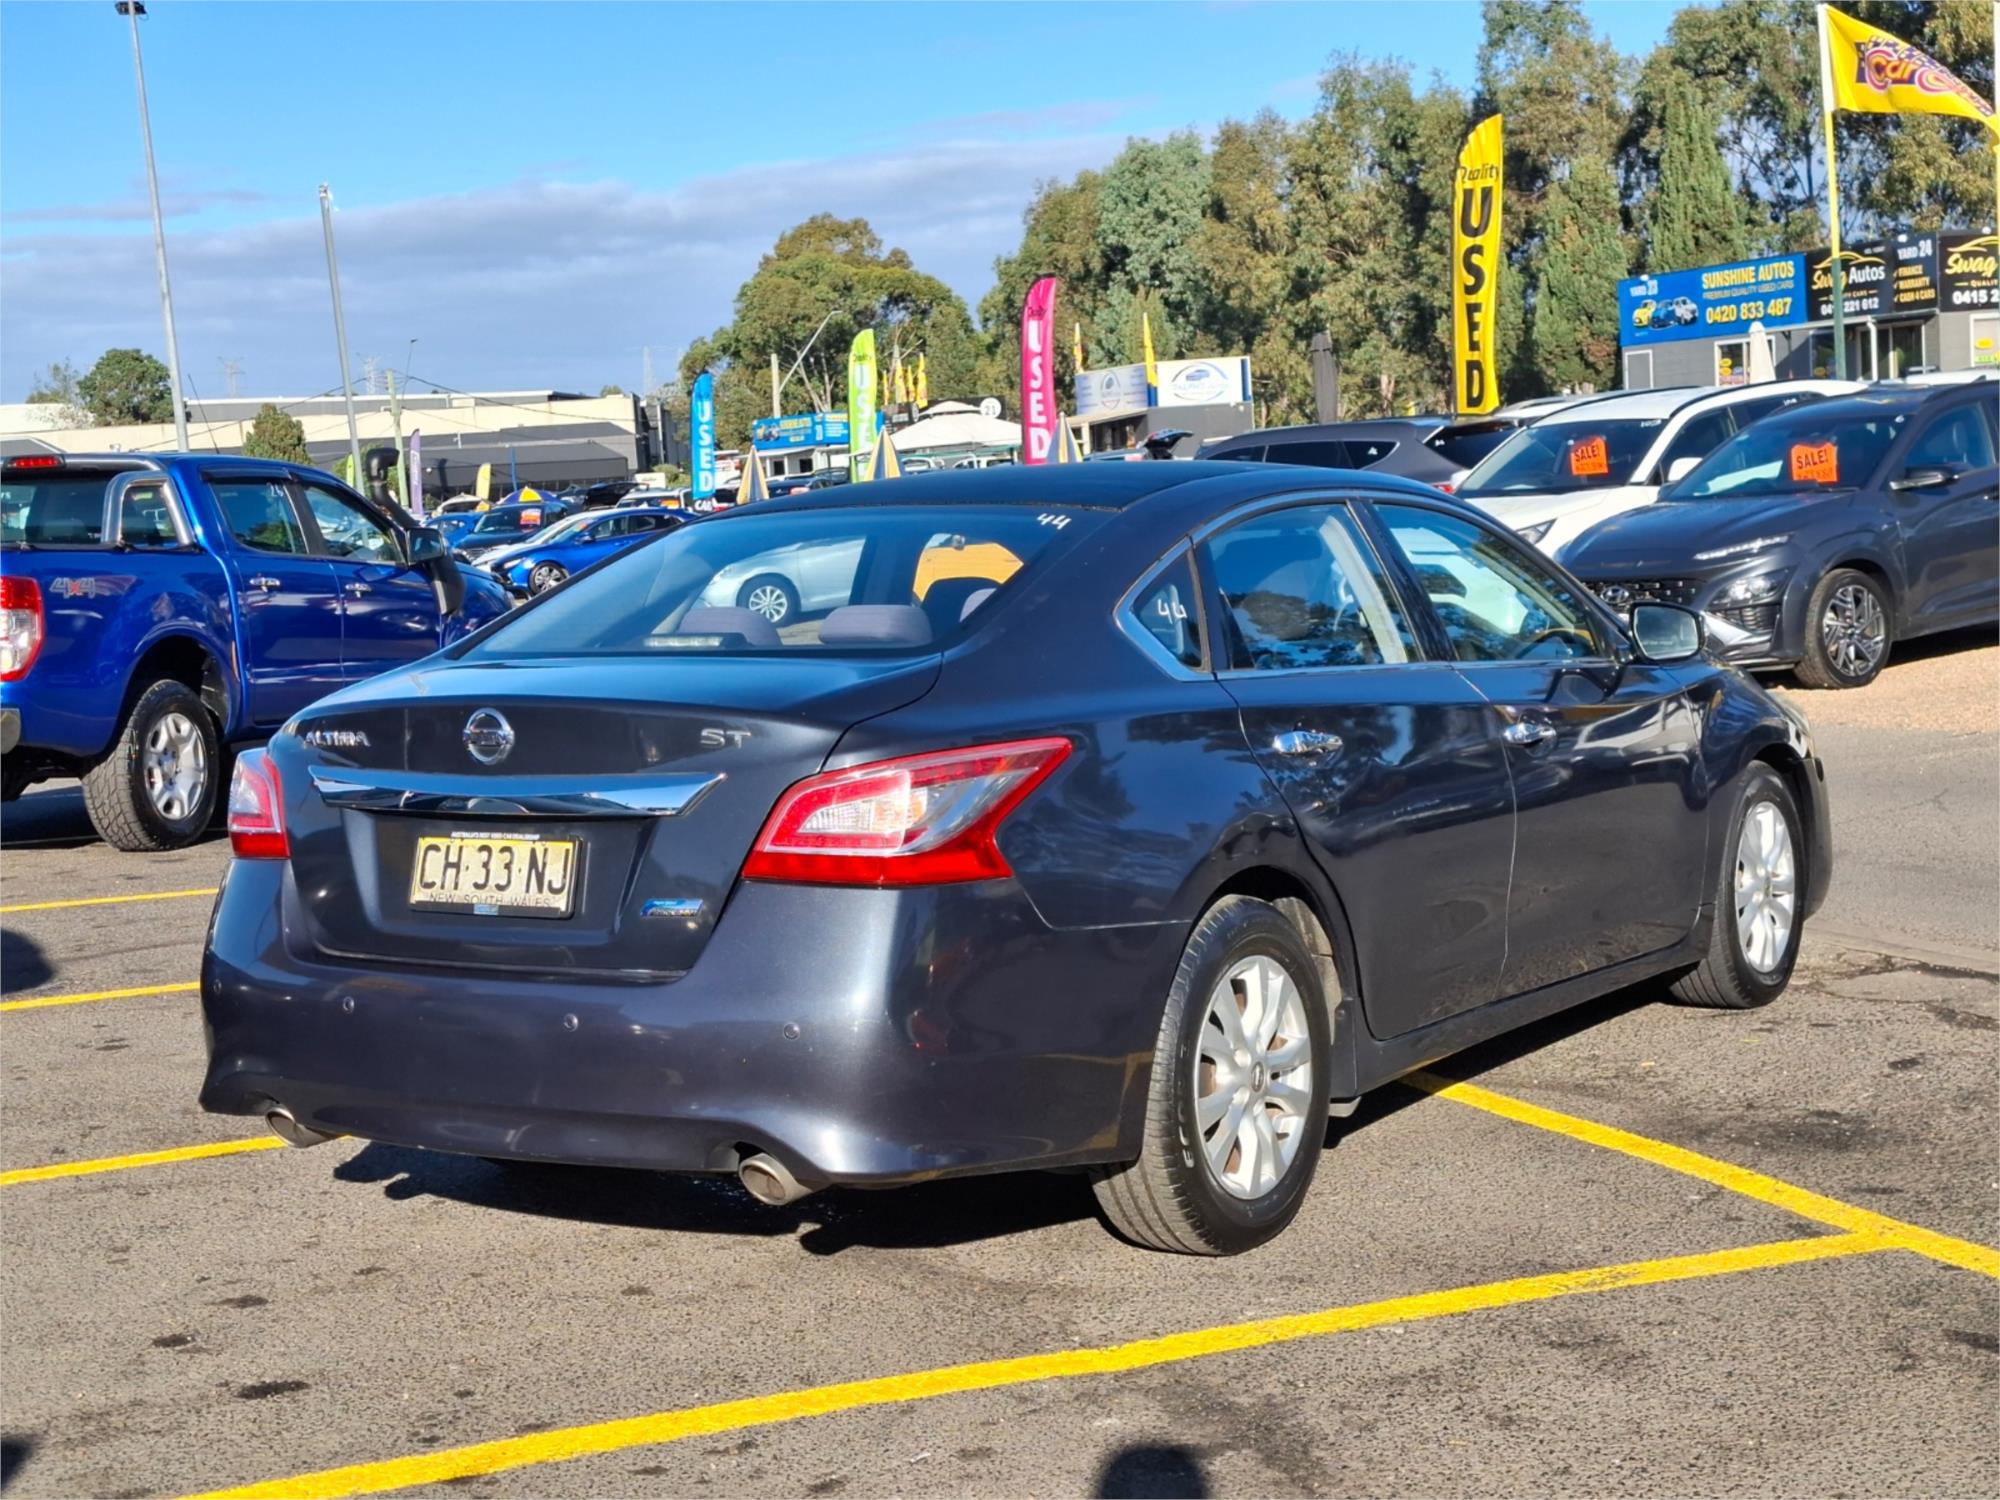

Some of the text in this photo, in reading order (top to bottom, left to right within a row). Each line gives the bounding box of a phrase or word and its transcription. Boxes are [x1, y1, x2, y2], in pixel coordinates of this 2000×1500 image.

[1897, 247, 1918, 260] YARD
[1918, 239, 1933, 256] 24
[1702, 261, 1795, 289] SUNSHINE AUTOS
[1945, 253, 1998, 277] Swag
[1811, 265, 1885, 292] Swg Autos
[1899, 277, 1931, 290] WARRANTY
[1460, 186, 1493, 408] USED
[1843, 300, 1860, 313] 221
[1861, 297, 1879, 311] 612
[1953, 289, 1988, 304] 0415
[1706, 297, 1792, 324] 0420 833 487
[1027, 320, 1051, 459] USED
[698, 400, 713, 492] USED
[1796, 449, 1829, 470] SALE!
[1037, 513, 1072, 530] 44
[49, 577, 96, 599] 4x4
[303, 731, 371, 748] ALTIMA
[700, 728, 752, 750] ST
[429, 893, 550, 907] NEW SOUTH WALES
